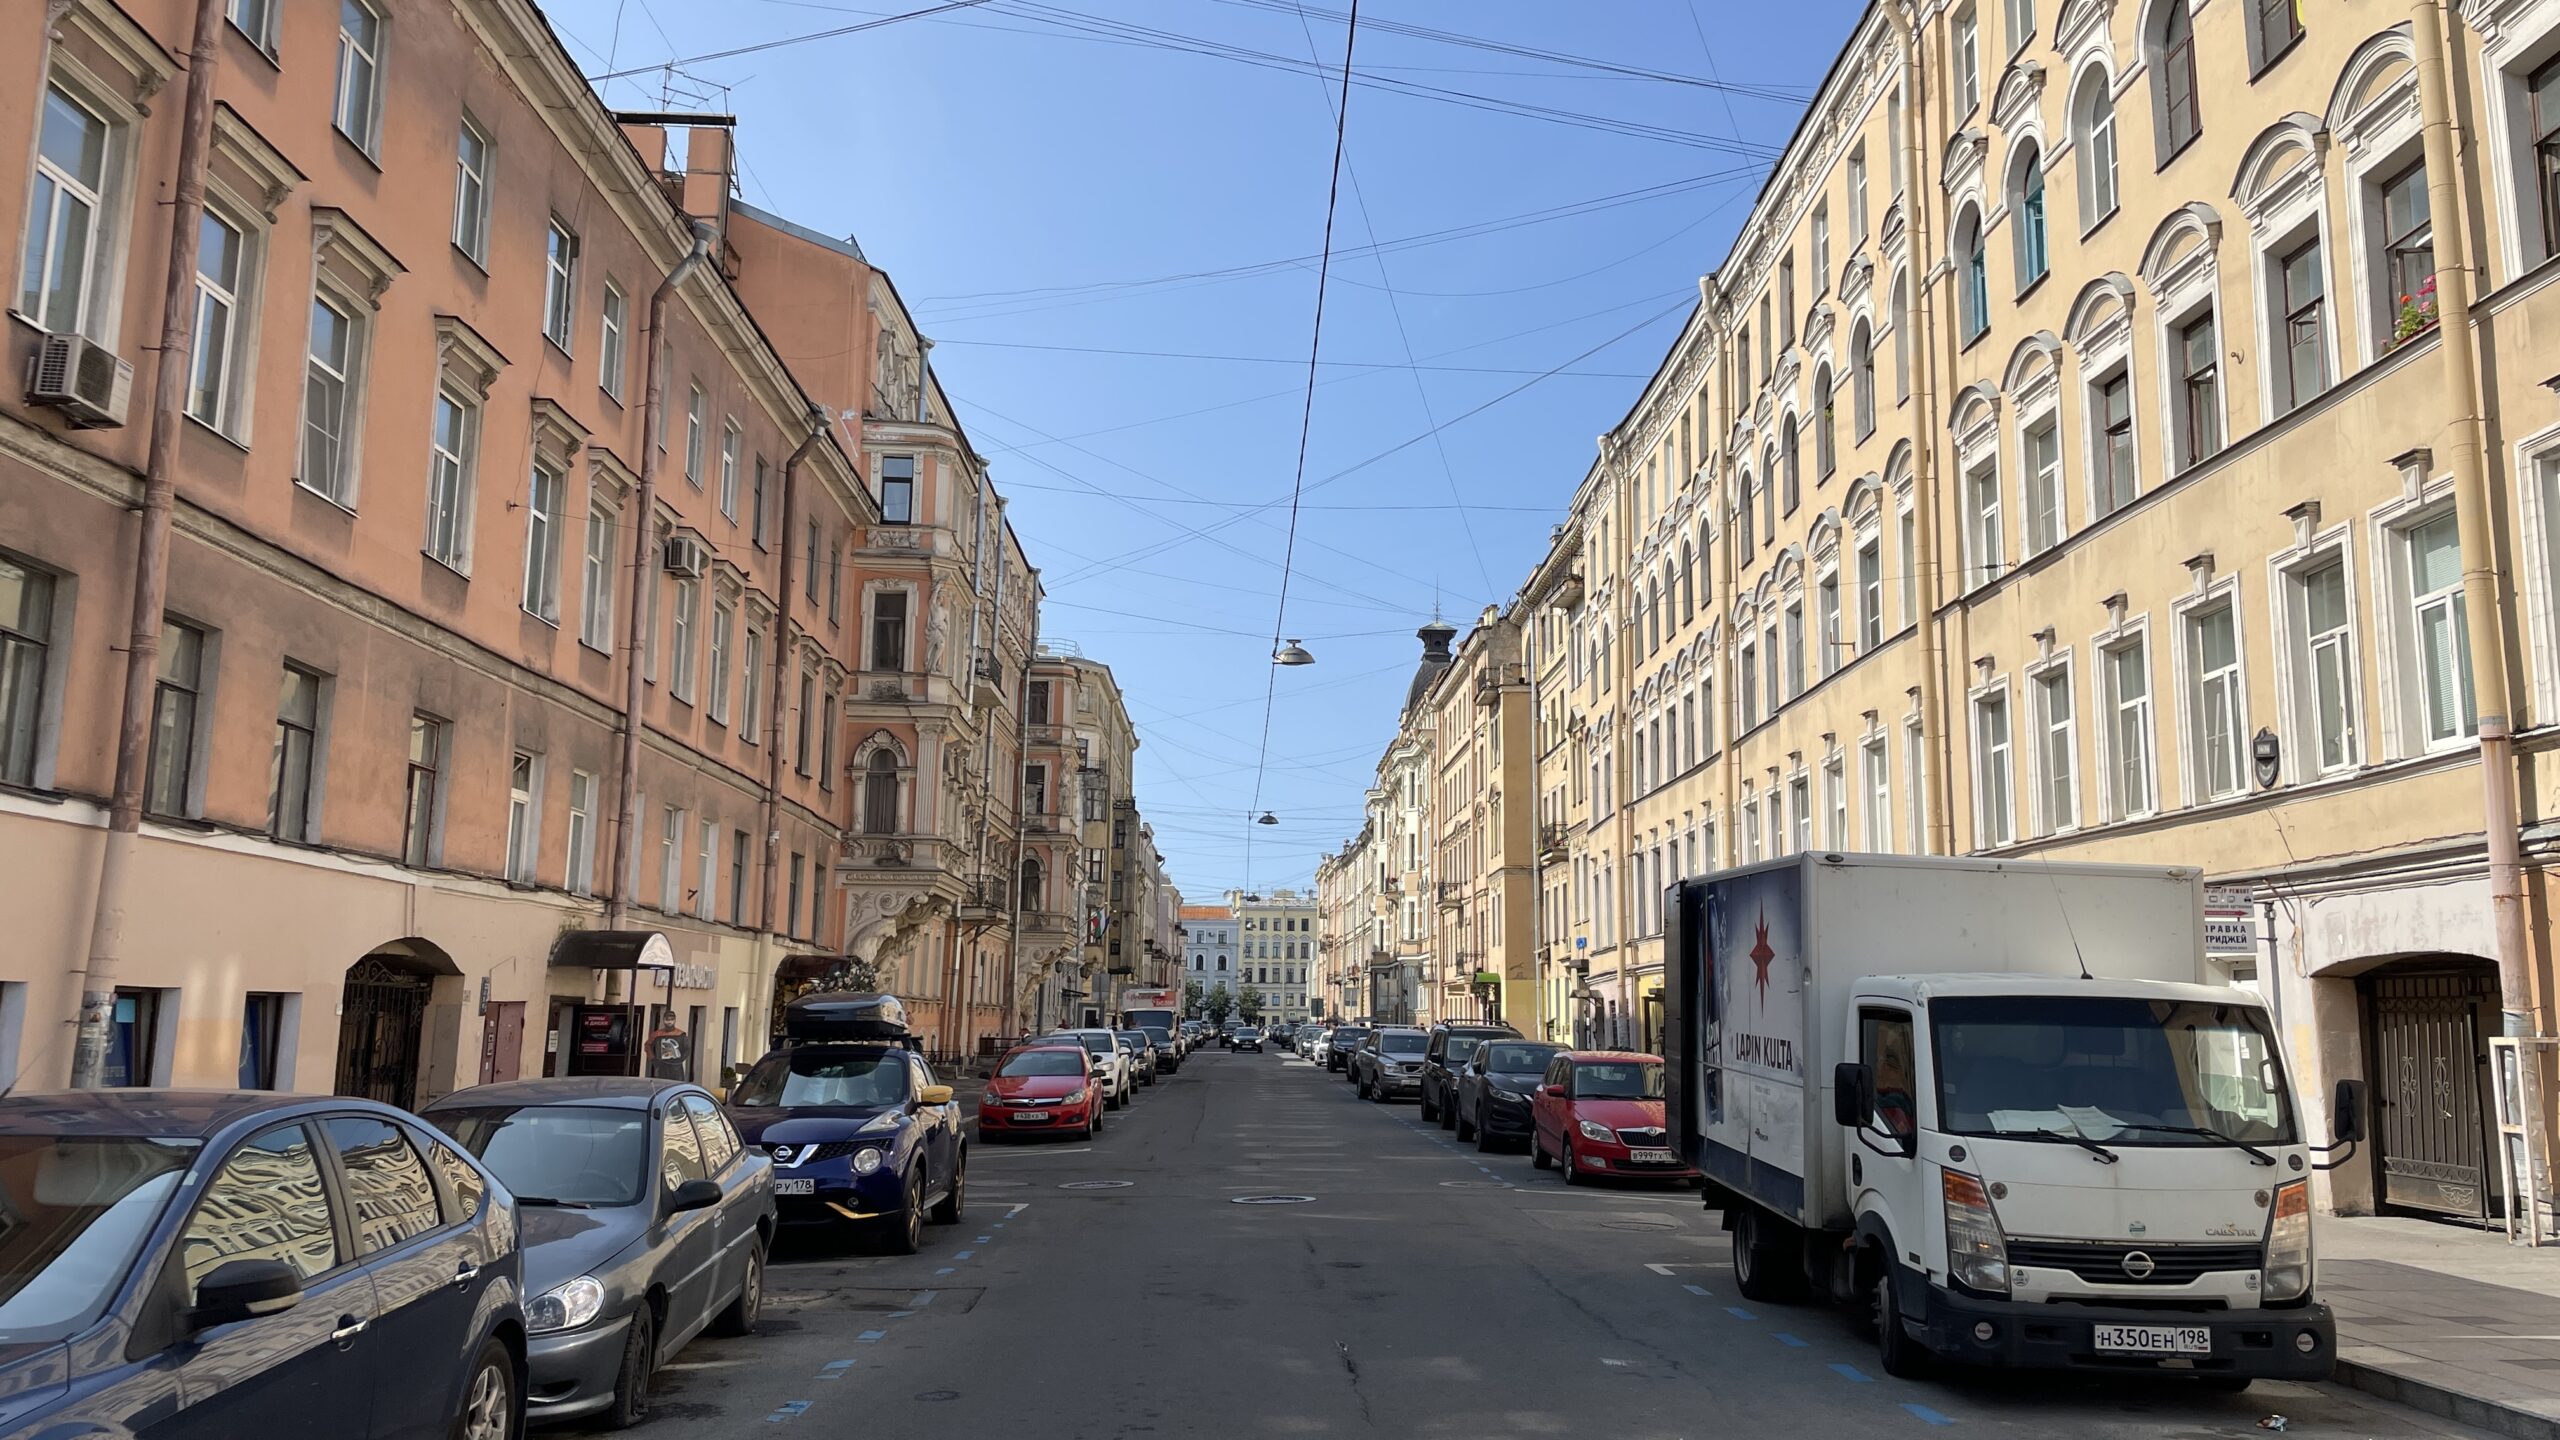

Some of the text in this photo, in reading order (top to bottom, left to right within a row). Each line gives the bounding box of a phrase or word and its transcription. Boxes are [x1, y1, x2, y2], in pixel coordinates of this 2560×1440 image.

[1735, 1032, 1793, 1072] LAPIN KULTA
[794, 1180, 811, 1189] 178
[2101, 1328, 2205, 1348] Н350ЕН 198
